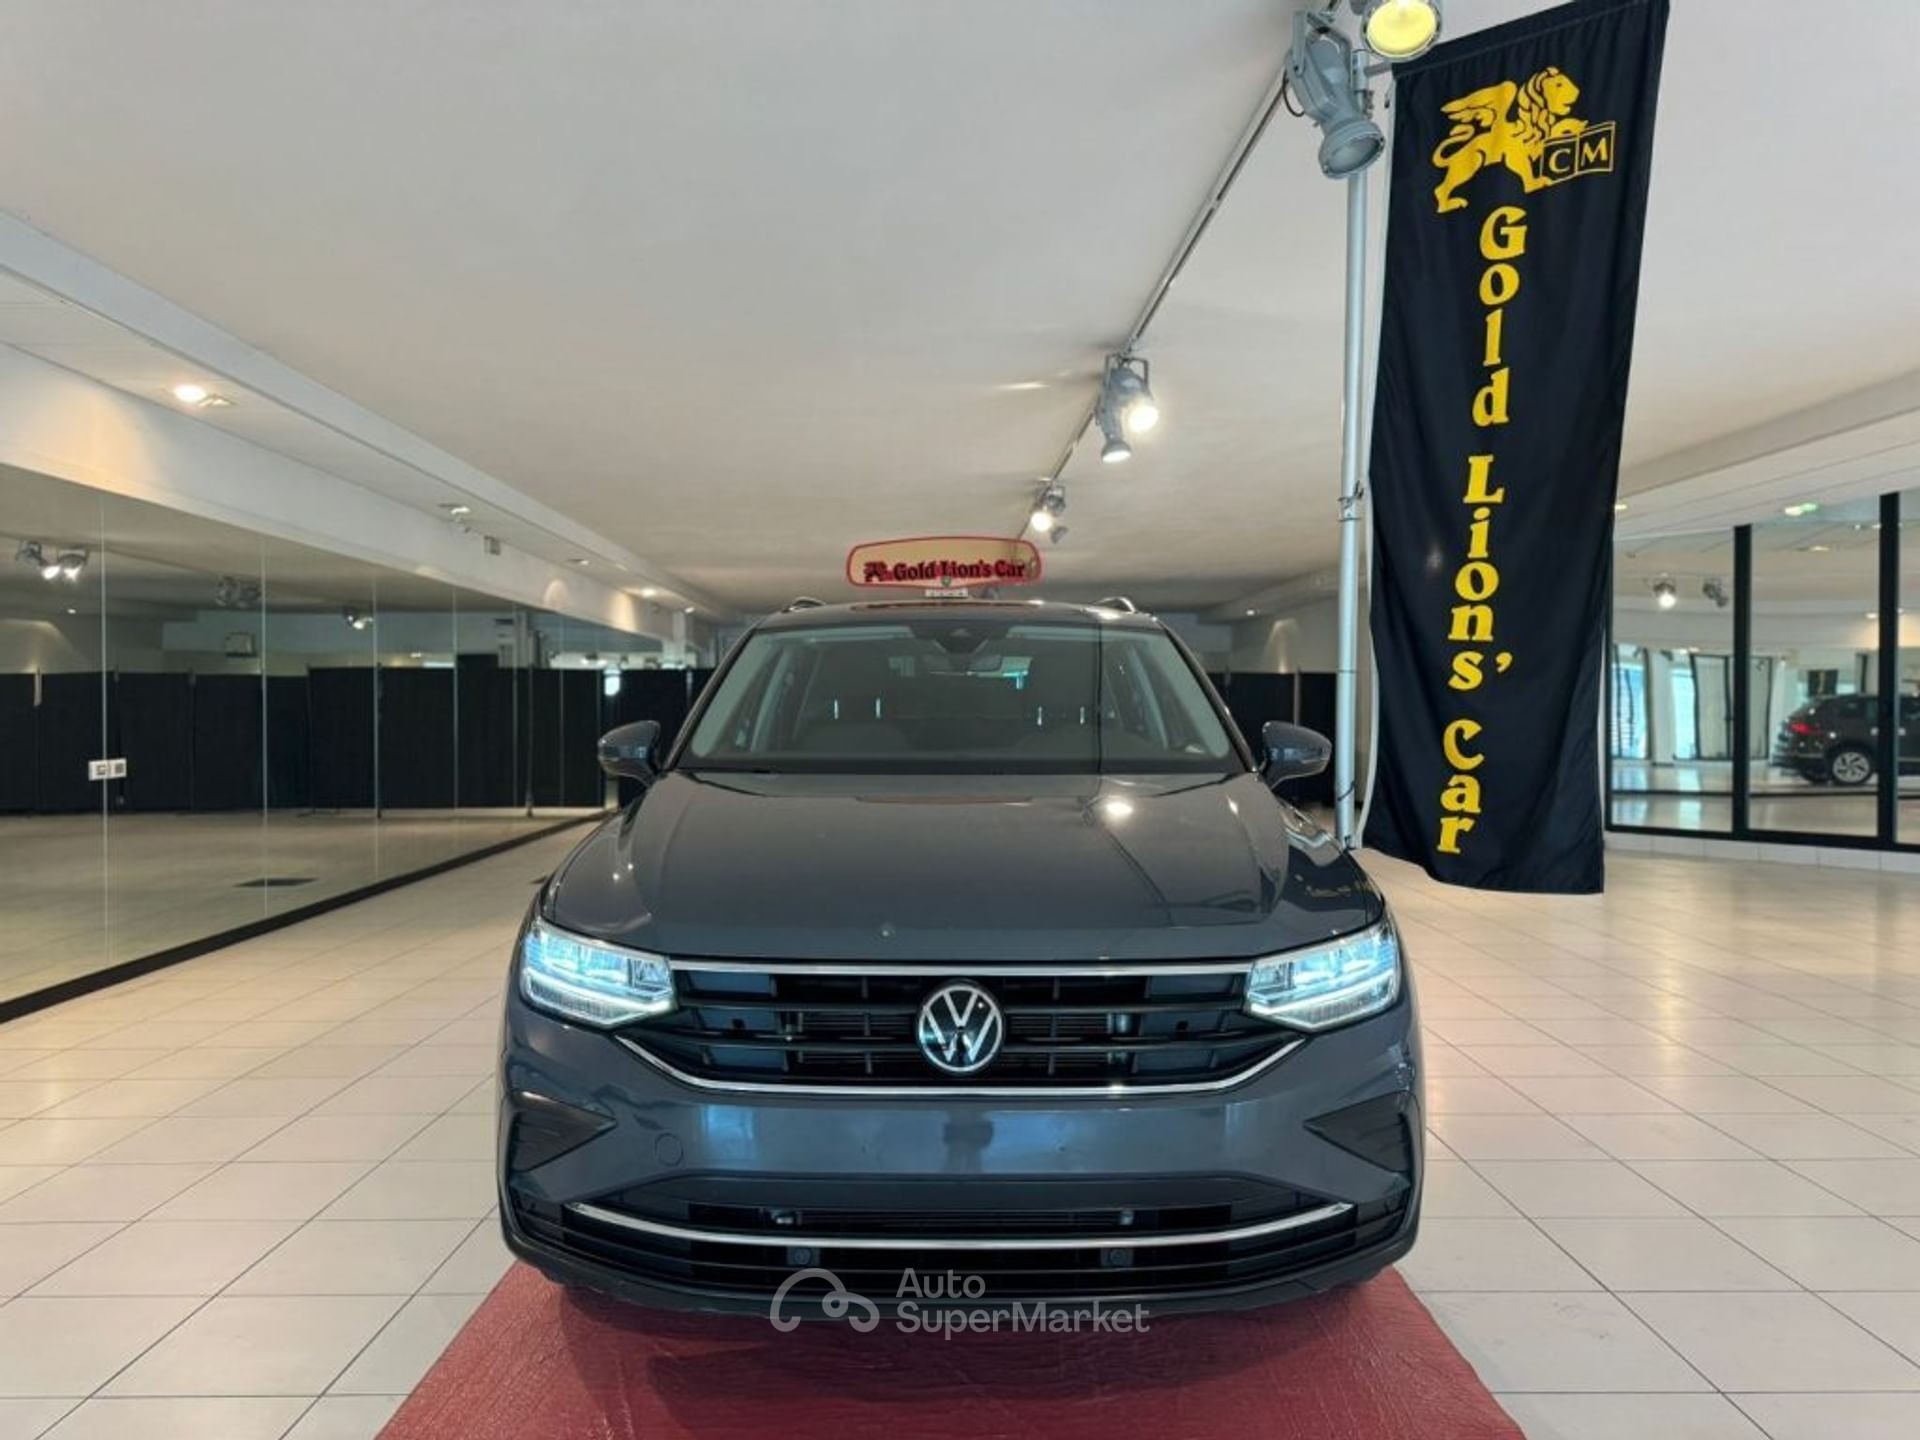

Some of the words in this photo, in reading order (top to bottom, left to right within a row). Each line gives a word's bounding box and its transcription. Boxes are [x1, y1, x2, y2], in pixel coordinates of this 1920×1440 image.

[1472, 206, 1528, 427] Gold
[892, 561, 935, 581] Gold
[937, 559, 992, 579] Lion's
[993, 560, 1026, 579] Car
